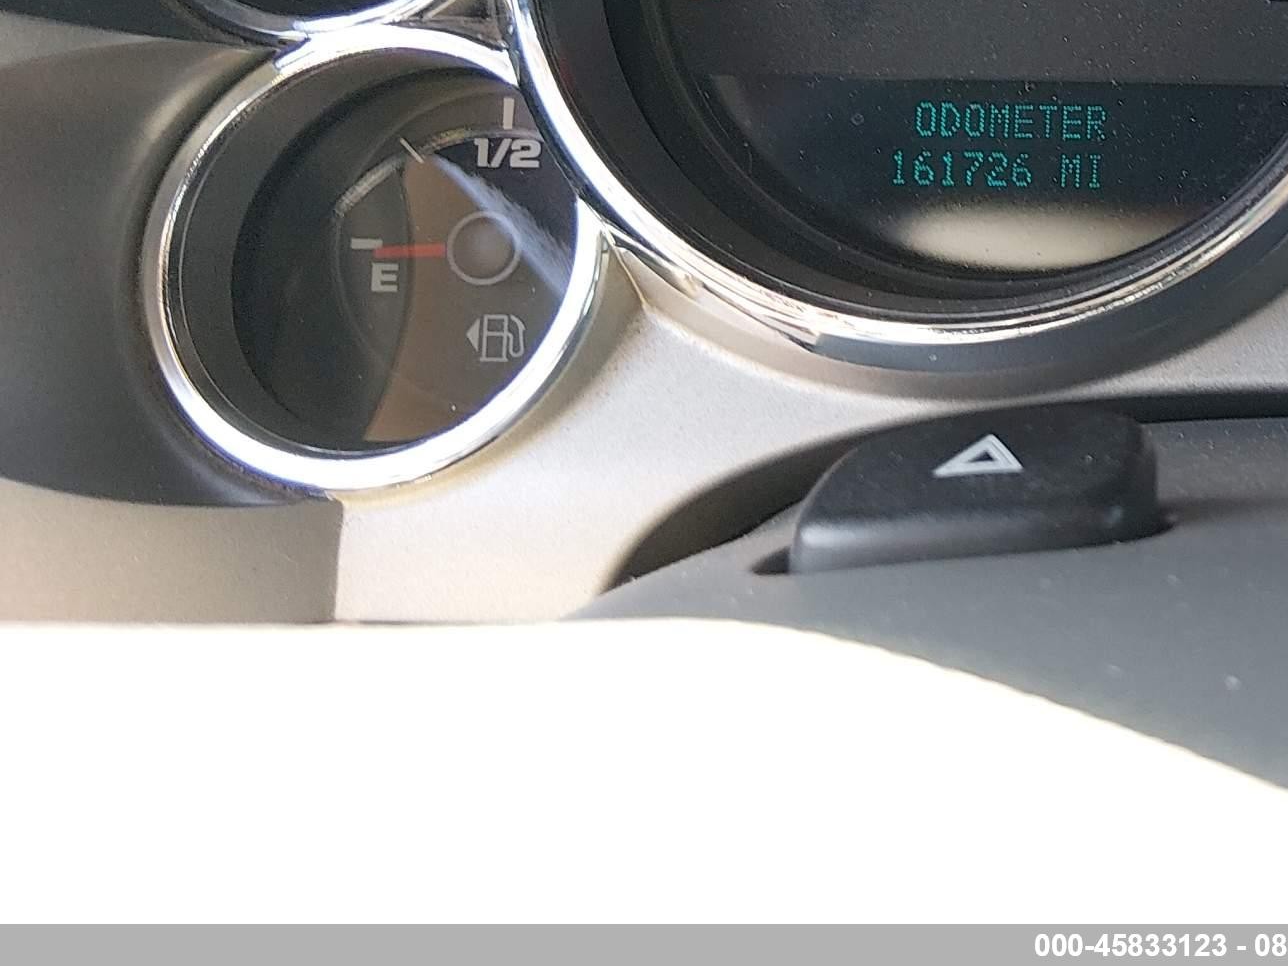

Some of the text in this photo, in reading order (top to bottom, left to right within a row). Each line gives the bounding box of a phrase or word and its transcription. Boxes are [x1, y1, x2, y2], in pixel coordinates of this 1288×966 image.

[916, 101, 1107, 140] ODOMETER
[474, 137, 542, 170] 1/2
[892, 149, 1101, 188] 161726 MI
[370, 262, 399, 293] E
